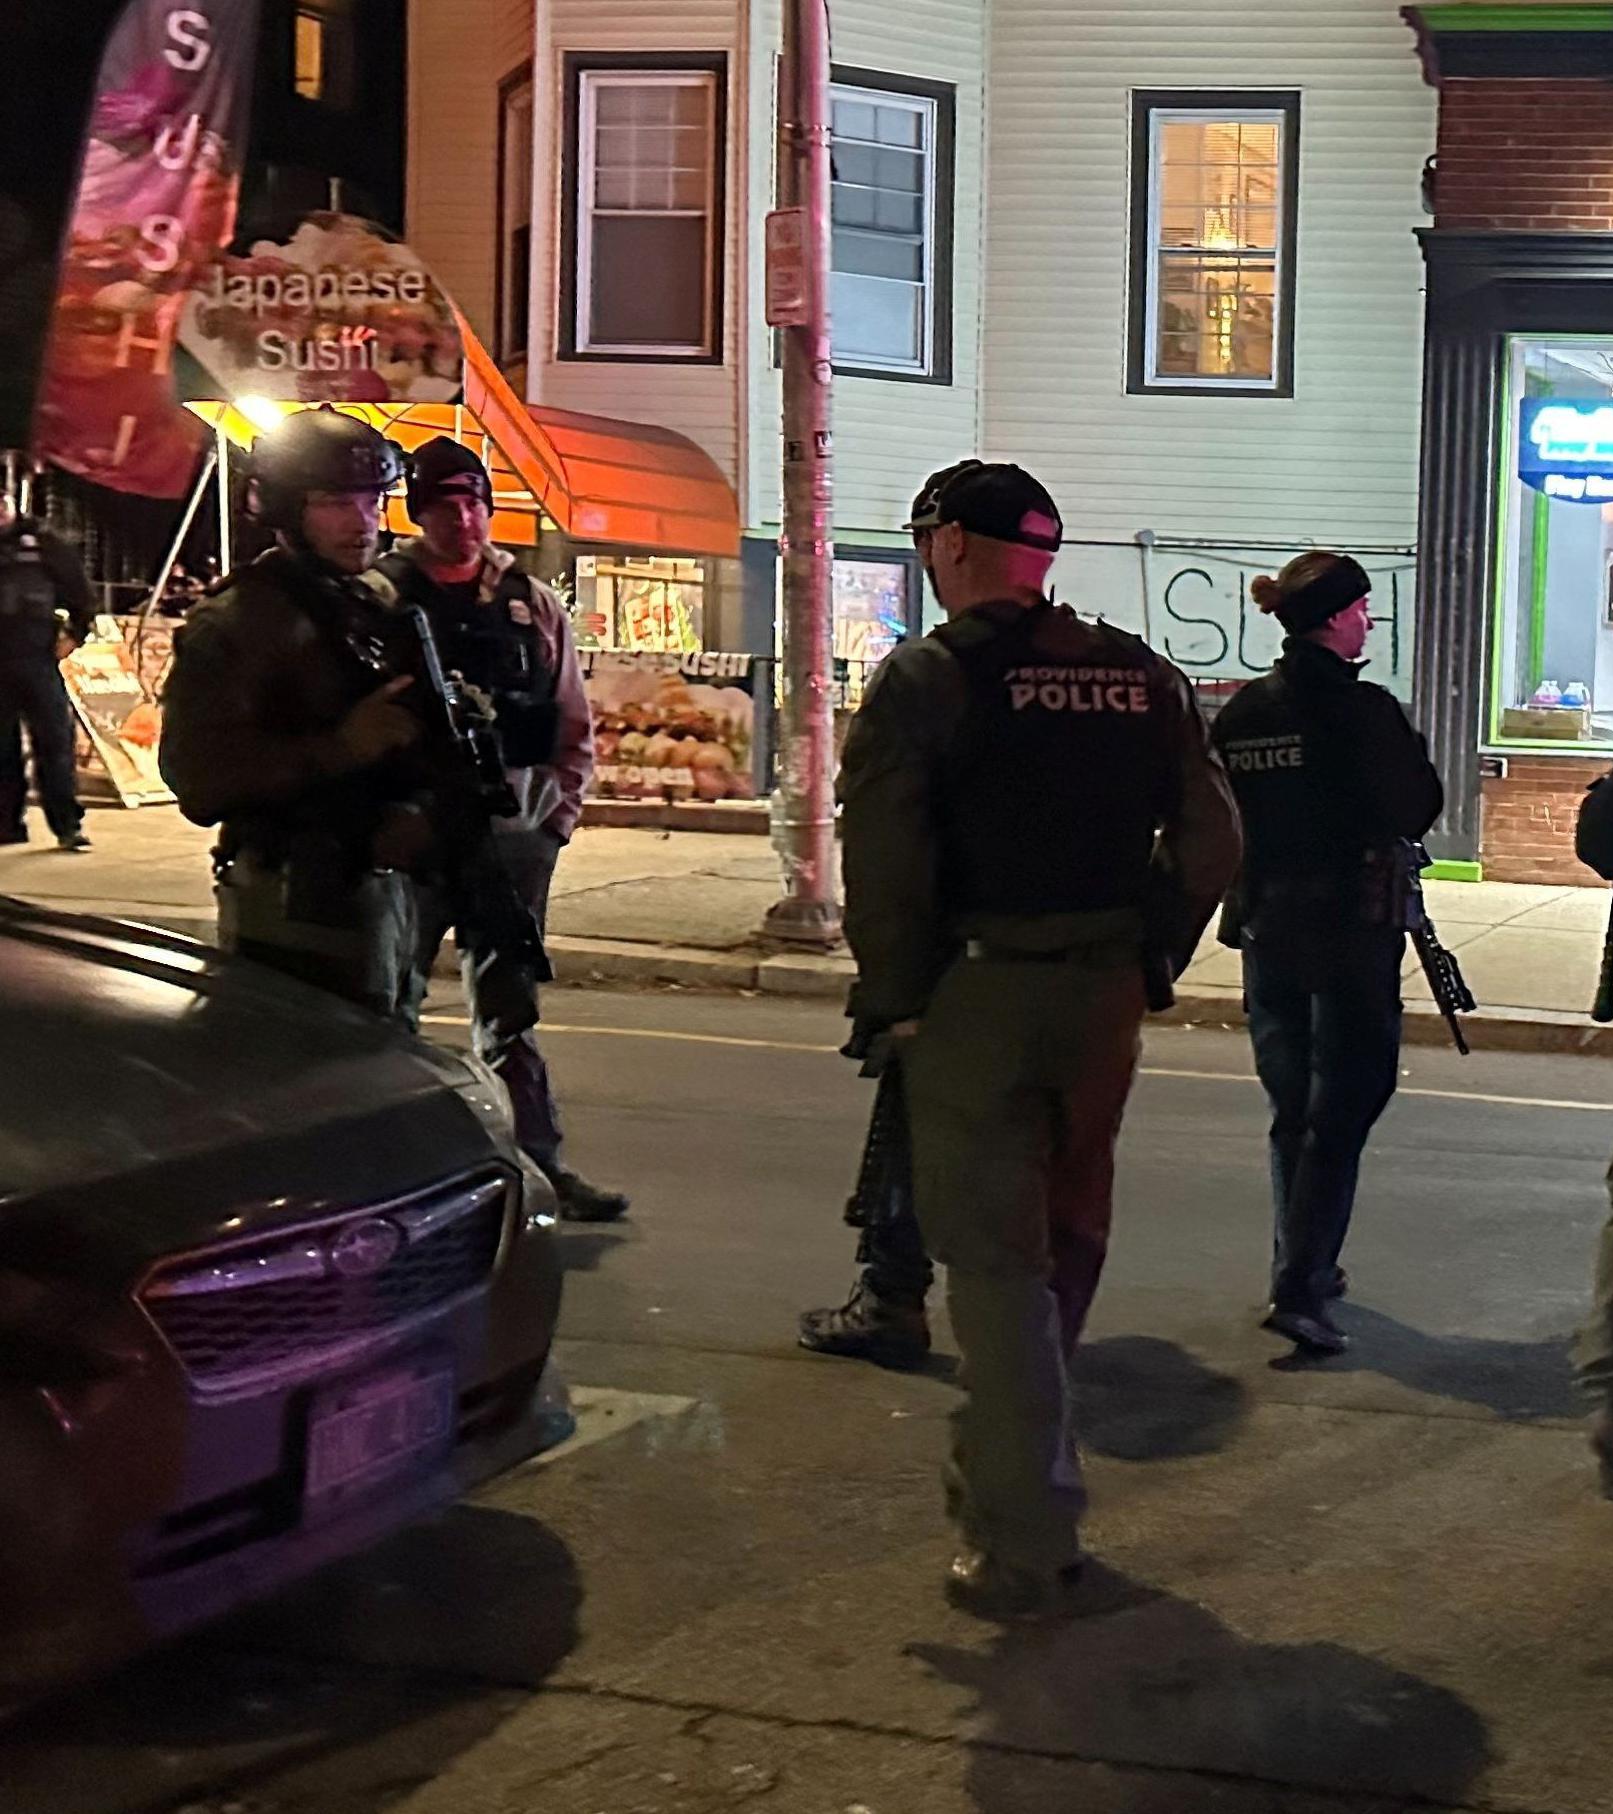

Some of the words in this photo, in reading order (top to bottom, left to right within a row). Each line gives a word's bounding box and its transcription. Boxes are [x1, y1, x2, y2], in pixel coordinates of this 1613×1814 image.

[112, 9, 212, 467] SUSHI
[201, 266, 427, 318] Japanese
[257, 329, 379, 371] Sushi
[1010, 684, 1150, 712] POLICE
[1228, 747, 1303, 770] POLICE
